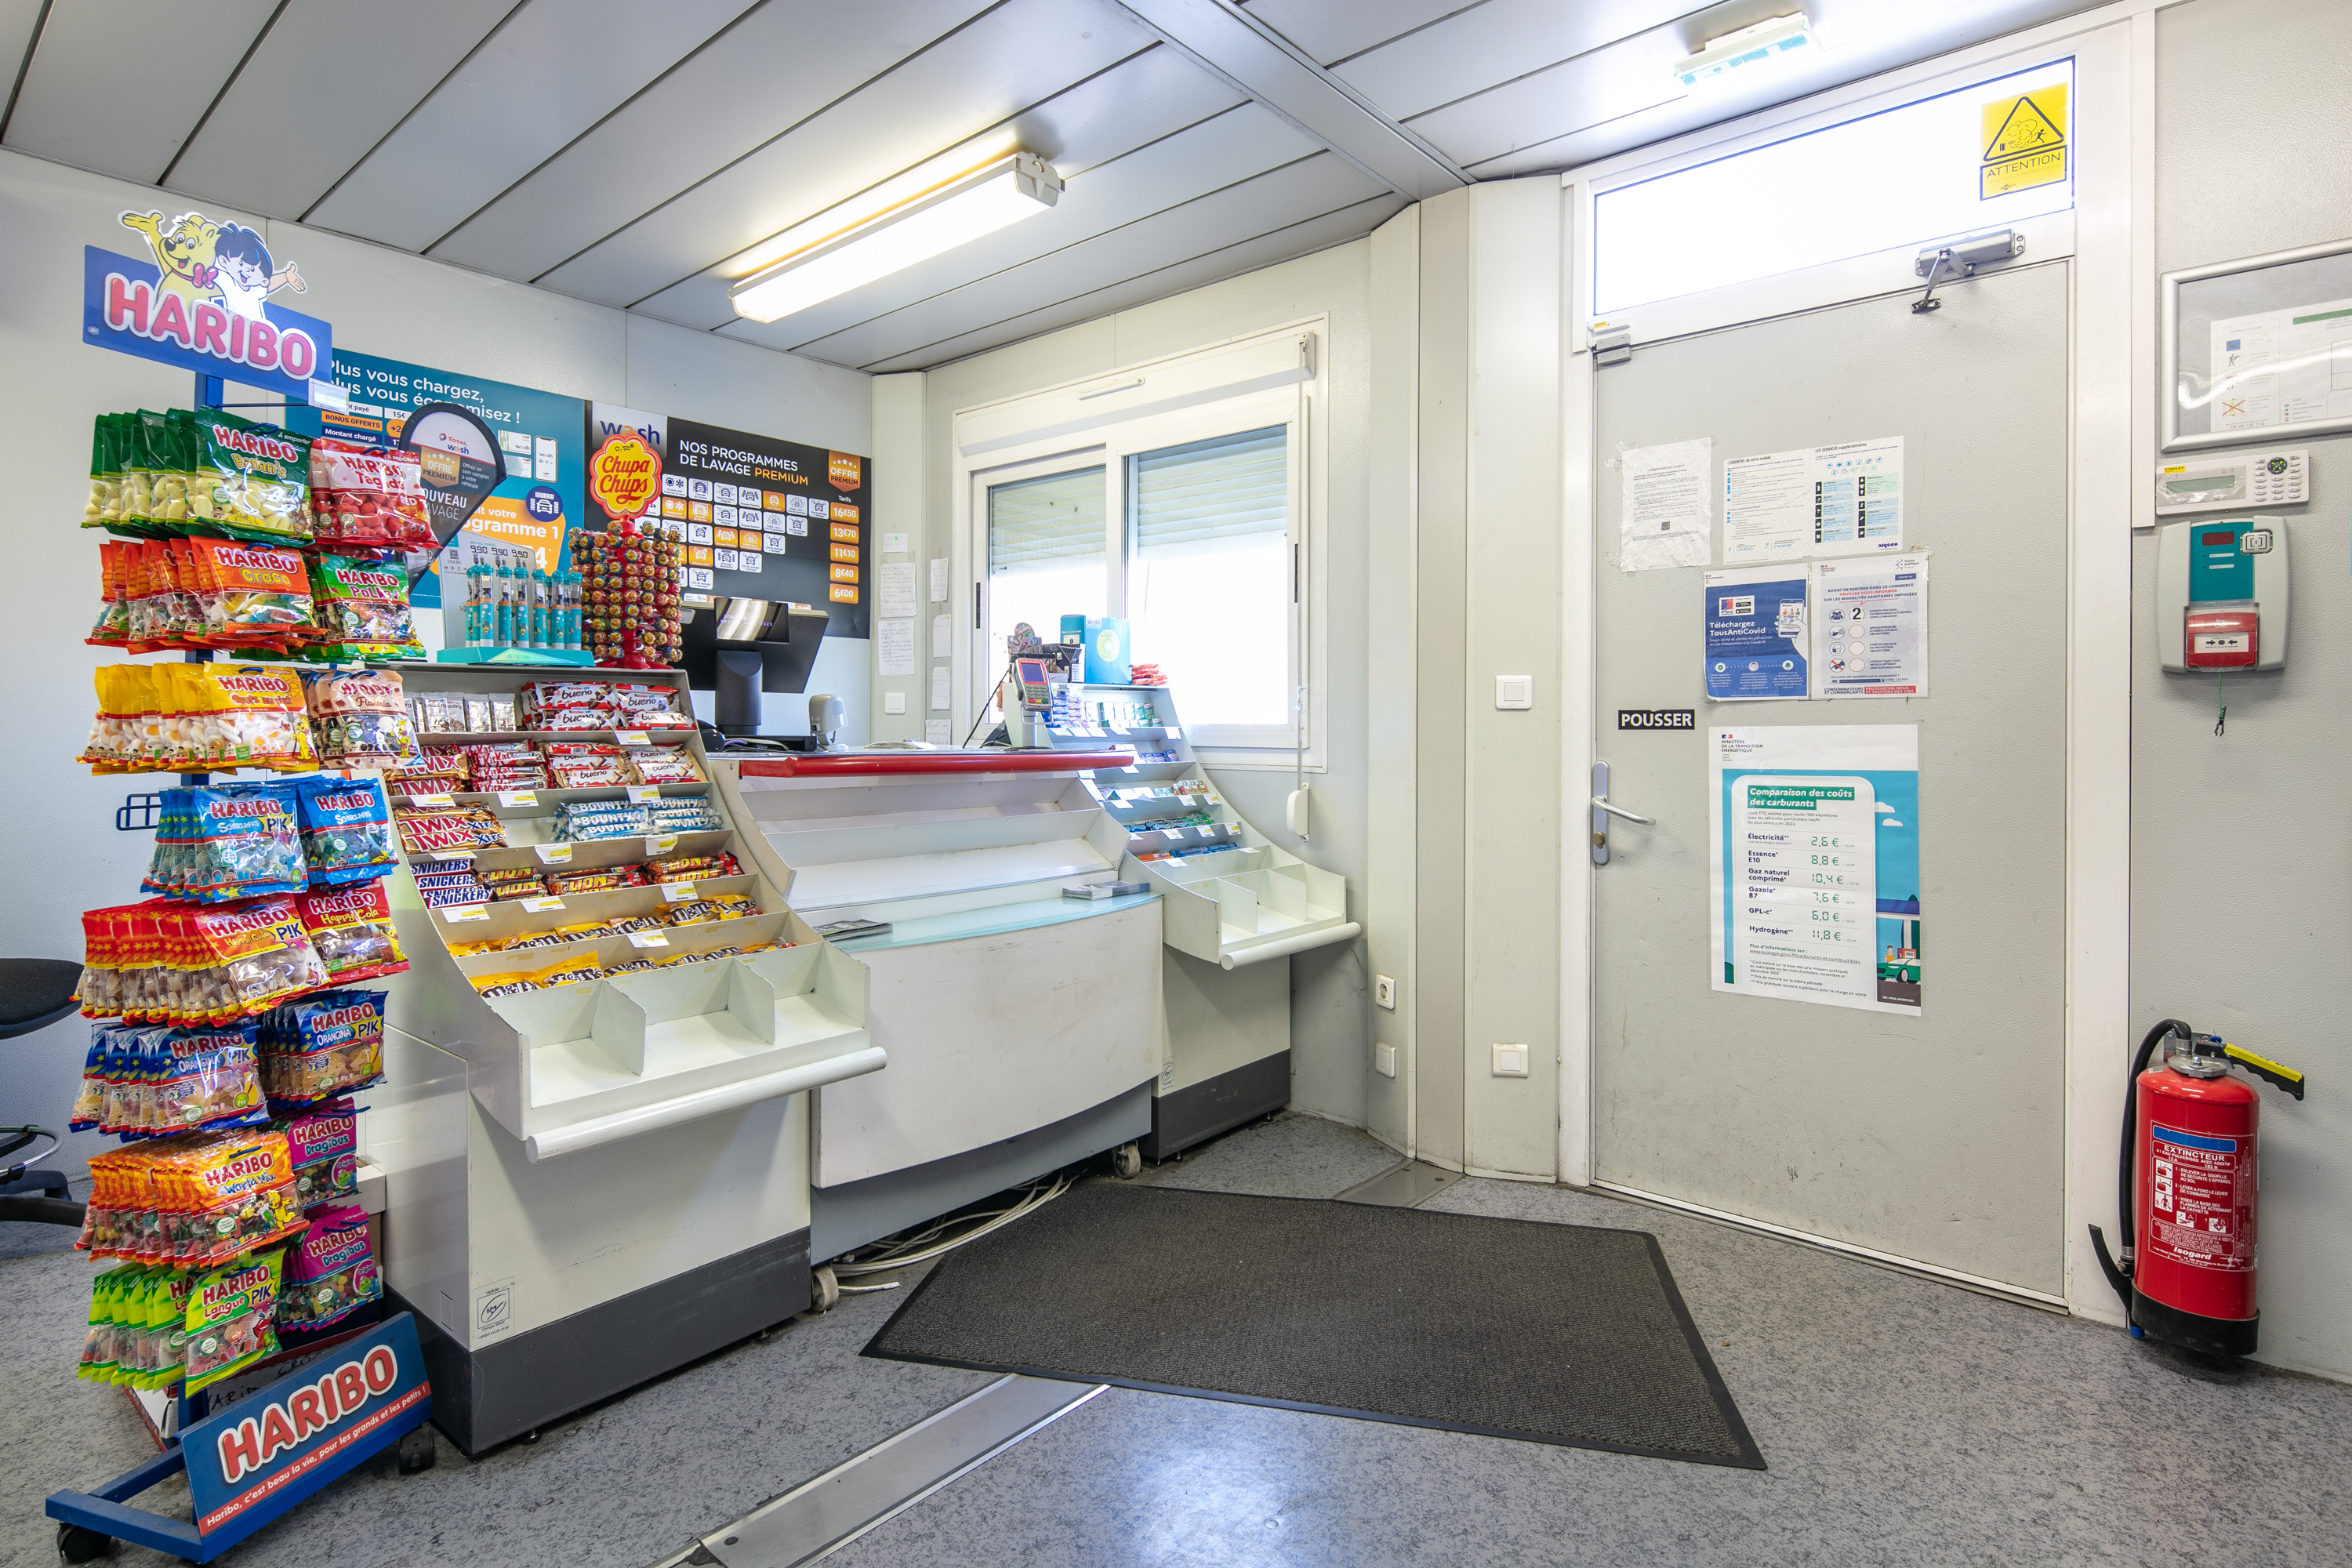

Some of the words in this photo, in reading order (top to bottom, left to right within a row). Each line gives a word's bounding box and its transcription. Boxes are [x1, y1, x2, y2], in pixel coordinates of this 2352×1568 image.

[1987, 153, 2060, 178] ATTENTION
[108, 276, 314, 377] HARIBO
[367, 369, 408, 387] vous
[413, 378, 484, 403] chargez,
[366, 387, 408, 403] vous
[351, 419, 380, 428] OFFERTS
[325, 429, 352, 437] Montant
[213, 425, 298, 463] HARIBO
[448, 437, 467, 445] TOTAL
[448, 445, 469, 455] wash
[680, 440, 707, 455] NOS
[712, 446, 797, 470] PROGRAMMES
[233, 454, 286, 478] Banan's
[343, 455, 405, 477] HARIBO
[427, 461, 452, 474] OFFRE
[602, 456, 650, 477] Chupa
[680, 453, 698, 466] DE
[702, 458, 750, 476] LAVAGE
[755, 467, 808, 485] PREMIUM
[830, 466, 858, 479] OFFRE
[423, 469, 456, 482] PREMIUM
[831, 476, 858, 485] PREMIUM
[600, 474, 648, 504] Chups
[488, 509, 517, 518] votre
[833, 508, 856, 517] 16€50
[551, 526, 558, 539] 1
[833, 528, 856, 538] 13€70
[214, 547, 298, 573] HARIBO
[834, 548, 855, 557] 11€10
[336, 569, 400, 587] HARIBO
[835, 568, 853, 578] 8€40
[834, 589, 853, 598] 6€00
[1853, 608, 1861, 619] 2
[1710, 627, 1766, 637] TousAntiCovid
[220, 677, 290, 692] HARIBO
[561, 689, 593, 699] bueno
[563, 714, 594, 724] bueno
[1622, 713, 1692, 726] POUSSER
[580, 770, 607, 779] bueno
[1750, 788, 1806, 797] Comparaison
[211, 800, 281, 818] HARIBO
[316, 793, 375, 811] HARIBO
[579, 801, 629, 811] BOUNTY
[652, 799, 699, 809] BOUNTY
[399, 817, 470, 834] TWIX
[582, 812, 633, 826] BOUNTY
[588, 823, 638, 834] BOUNTY
[406, 830, 474, 852] TWIX
[1831, 838, 1839, 848] €
[412, 860, 469, 875] SNICKERS
[1832, 856, 1839, 866] €
[419, 875, 476, 888] SNICKERS
[490, 868, 532, 880] LION
[1836, 875, 1844, 884] €
[496, 882, 538, 896] LION
[568, 876, 607, 892] LION
[308, 892, 377, 915] HARIBO
[433, 889, 492, 906] SNICKERS
[208, 908, 289, 938] HARIBO
[320, 913, 353, 924] Happy
[358, 909, 379, 920] Cola
[225, 936, 250, 946] Happy
[252, 932, 269, 942] Cola
[311, 1003, 376, 1033] HARIBO
[317, 1028, 352, 1046] ORANGINA
[171, 1033, 243, 1058] HARIBO
[294, 1117, 354, 1145] HARIBO
[305, 1134, 349, 1156] Dragibus
[2164, 1145, 2225, 1161] EXTINCTEUR
[205, 1152, 274, 1187] HARIBO
[225, 1178, 256, 1194] World
[260, 1172, 277, 1183] Mix
[307, 1224, 367, 1257] HARIBO
[322, 1241, 365, 1267] Dragibus
[2174, 1247, 2212, 1260] Isogard
[202, 1265, 270, 1305] HARIBO
[204, 1296, 245, 1321] Langue
[220, 1347, 396, 1480] HARIBO
[207, 1502, 241, 1526] Haribo,
[267, 1471, 289, 1489] beau
[292, 1464, 300, 1473] la
[303, 1457, 317, 1468] vie,
[318, 1443, 337, 1458] pour
[339, 1434, 351, 1446] les
[353, 1417, 379, 1437] grands
[381, 1410, 388, 1419] et
[390, 1403, 401, 1414] les
[401, 1391, 422, 1408] petits
